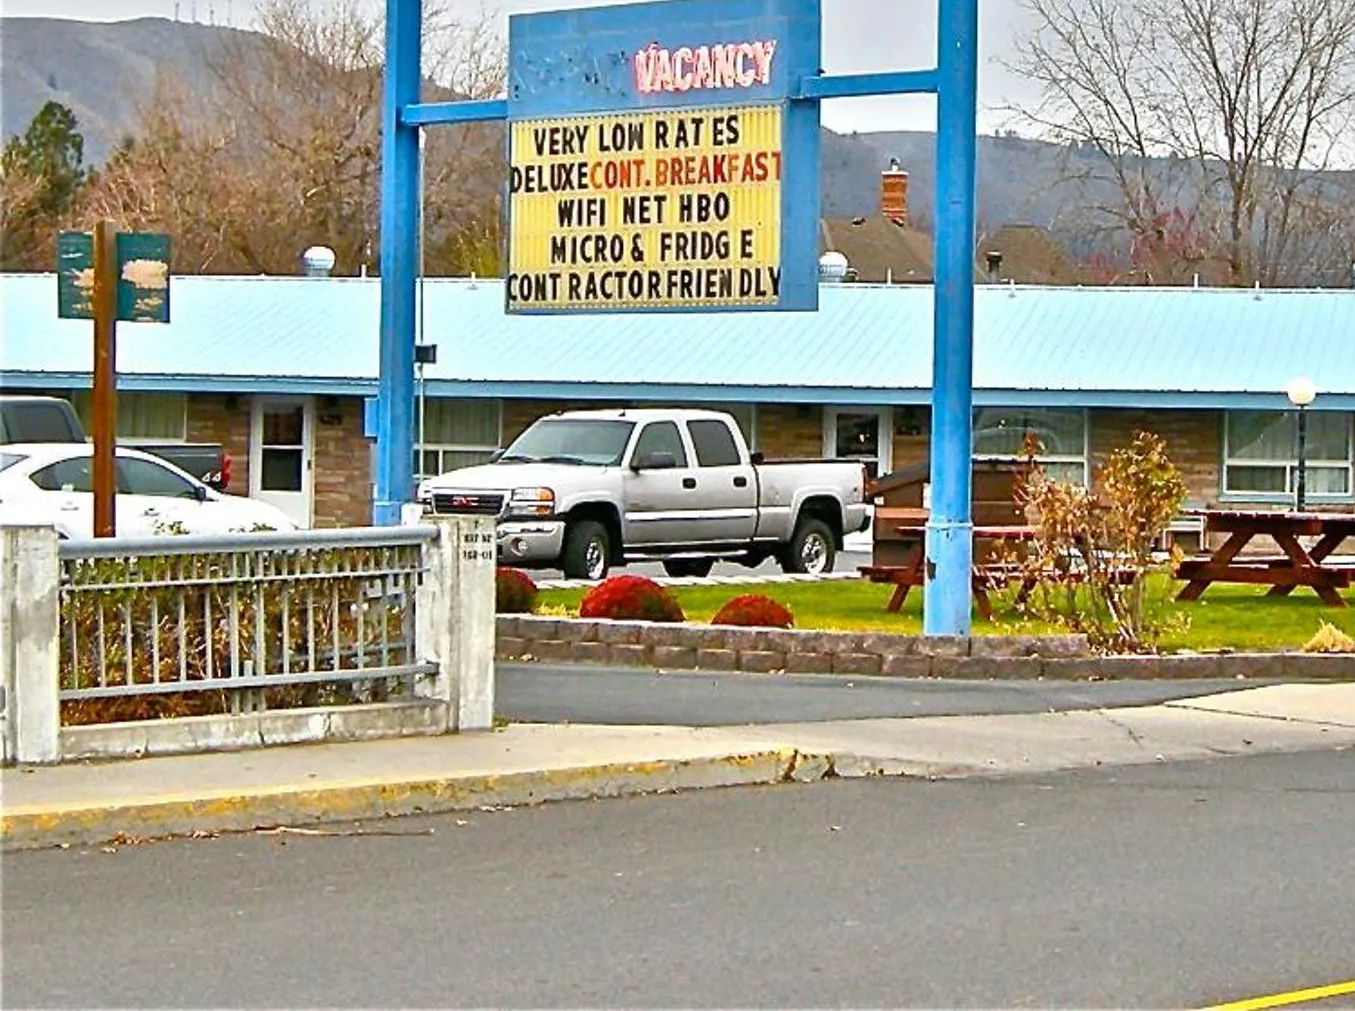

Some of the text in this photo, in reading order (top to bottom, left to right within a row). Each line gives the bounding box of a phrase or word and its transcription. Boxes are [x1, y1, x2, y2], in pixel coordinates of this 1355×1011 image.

[633, 39, 777, 94] VACANCY
[534, 115, 739, 156] VERY LOW RATES
[511, 151, 781, 193] DELUXE CONT. BREAKFAST
[557, 191, 730, 227] WIFI NET HBO
[550, 234, 623, 264] MICRO
[660, 229, 754, 262] FRIDGE
[666, 266, 781, 299] FRIENDLY
